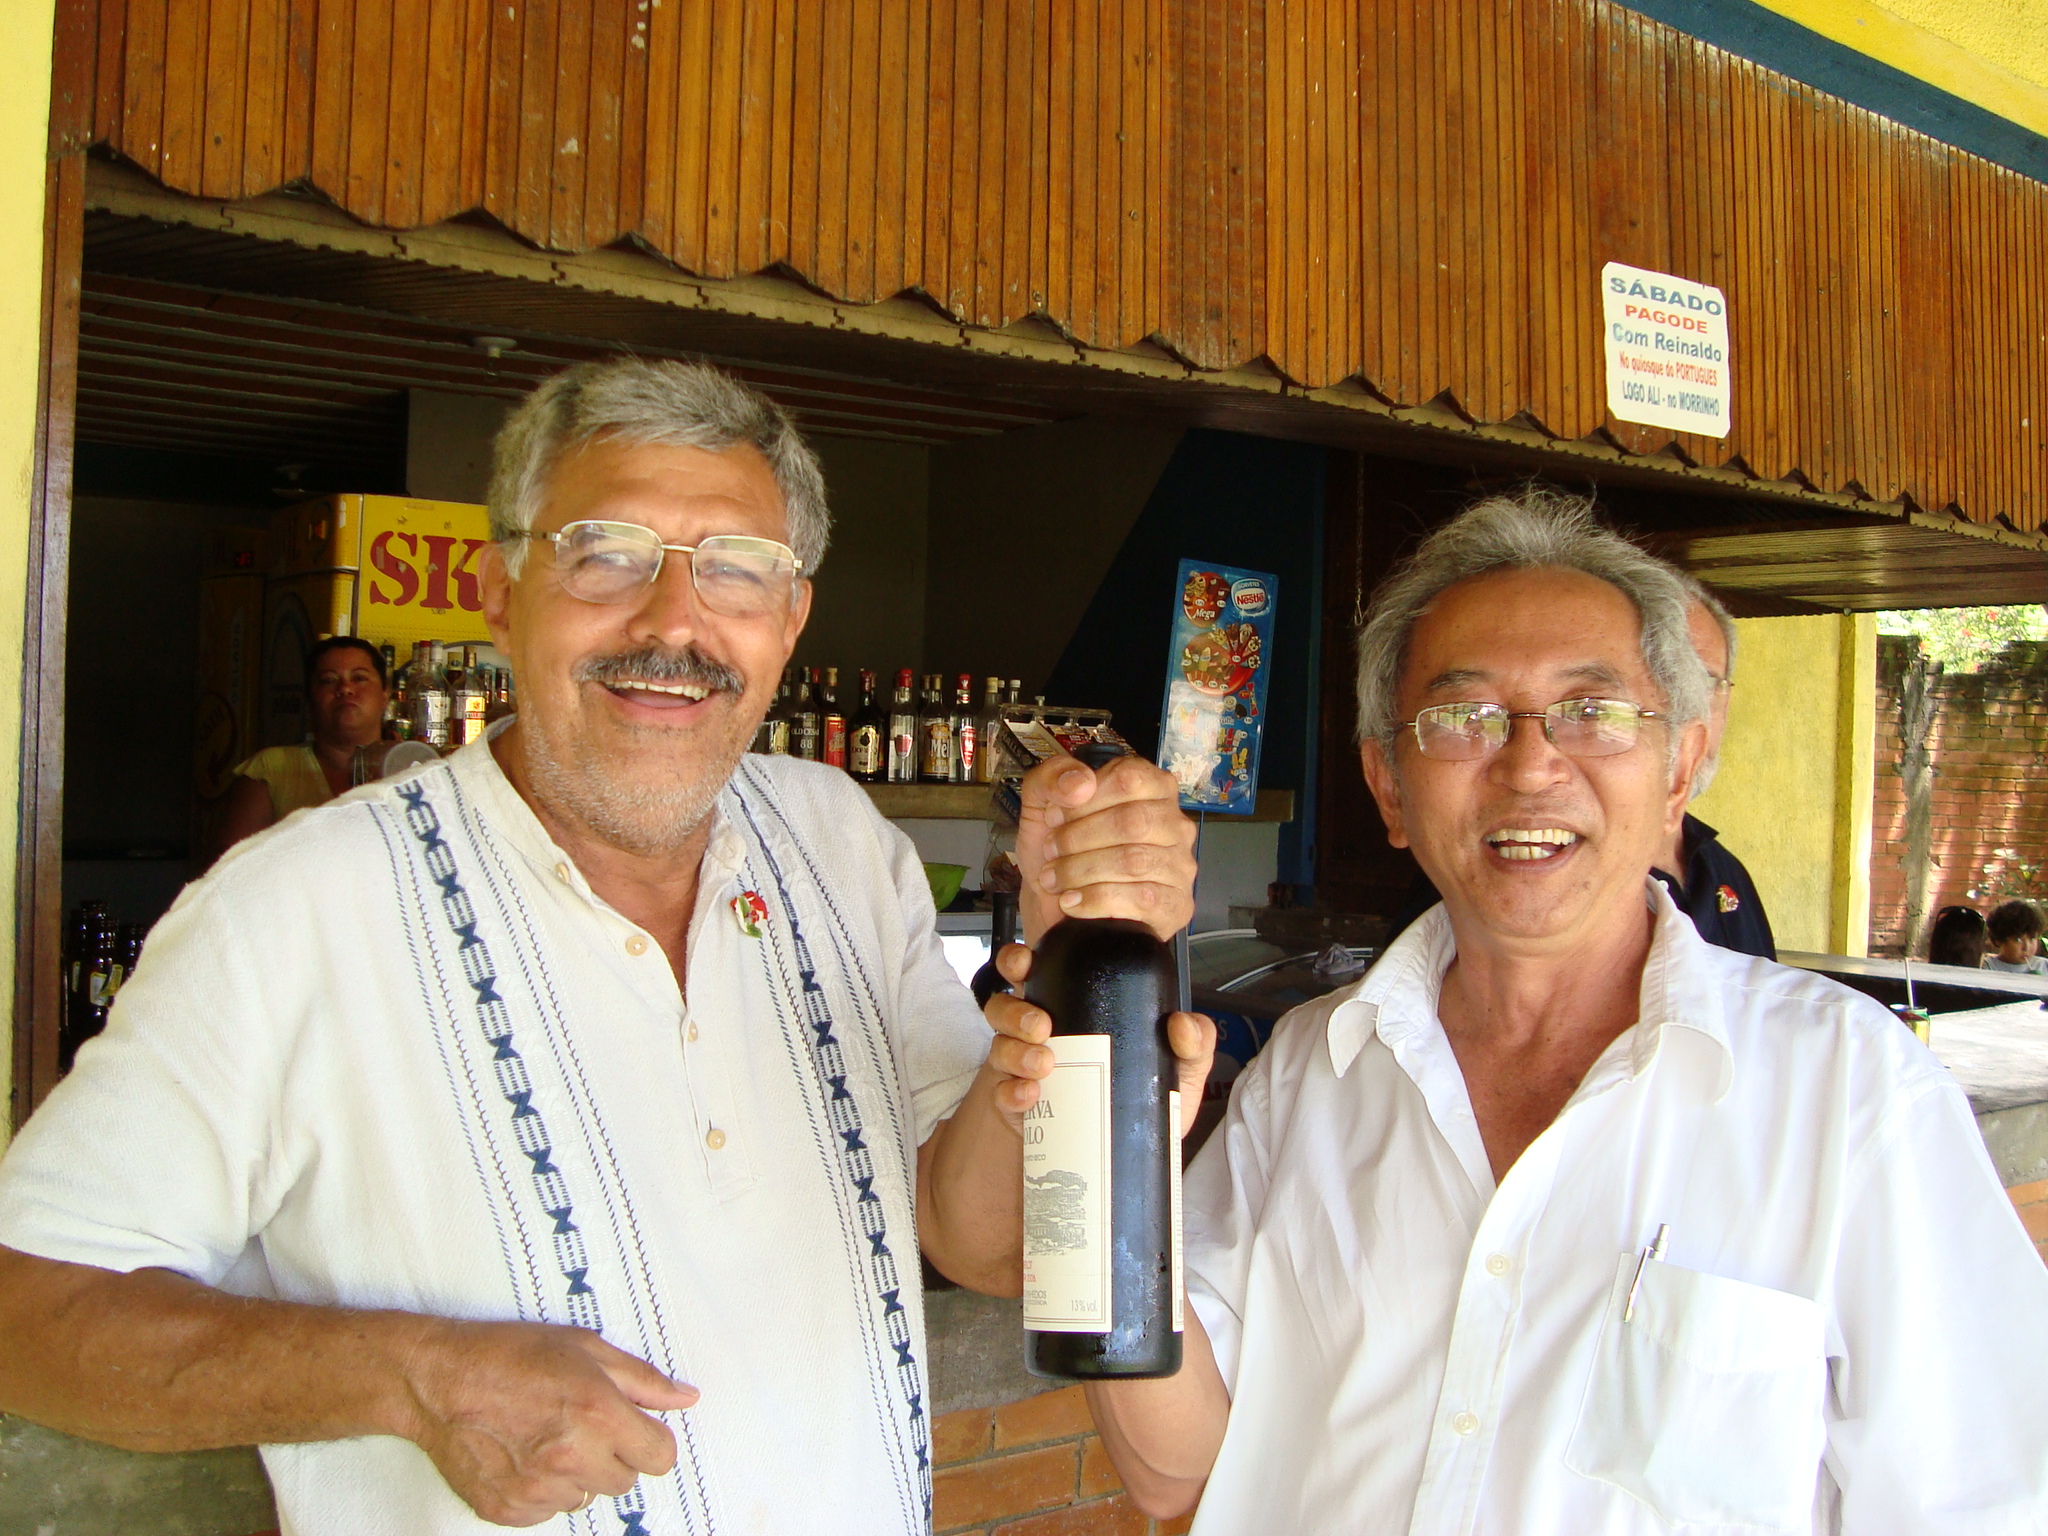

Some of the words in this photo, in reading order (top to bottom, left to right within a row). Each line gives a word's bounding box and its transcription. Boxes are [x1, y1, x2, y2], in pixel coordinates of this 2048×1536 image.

[1610, 277, 1722, 316] SÁBADO
[1625, 304, 1708, 334] PAGODE
[1612, 323, 1648, 347] Com
[1655, 332, 1722, 362] Reinaldo
[1619, 351, 1629, 369] No
[1632, 355, 1663, 379] quiosque
[1665, 363, 1675, 378] do
[1622, 380, 1645, 402] LOGO
[1647, 385, 1661, 406] ALI
[1668, 393, 1677, 408] no
[1679, 390, 1720, 417] MORRINHO
[1192, 608, 1215, 620] Mega
[800, 739, 813, 749] 88
[1001, 732, 1021, 757] HALLS
[1071, 1299, 1085, 1312] 13%
